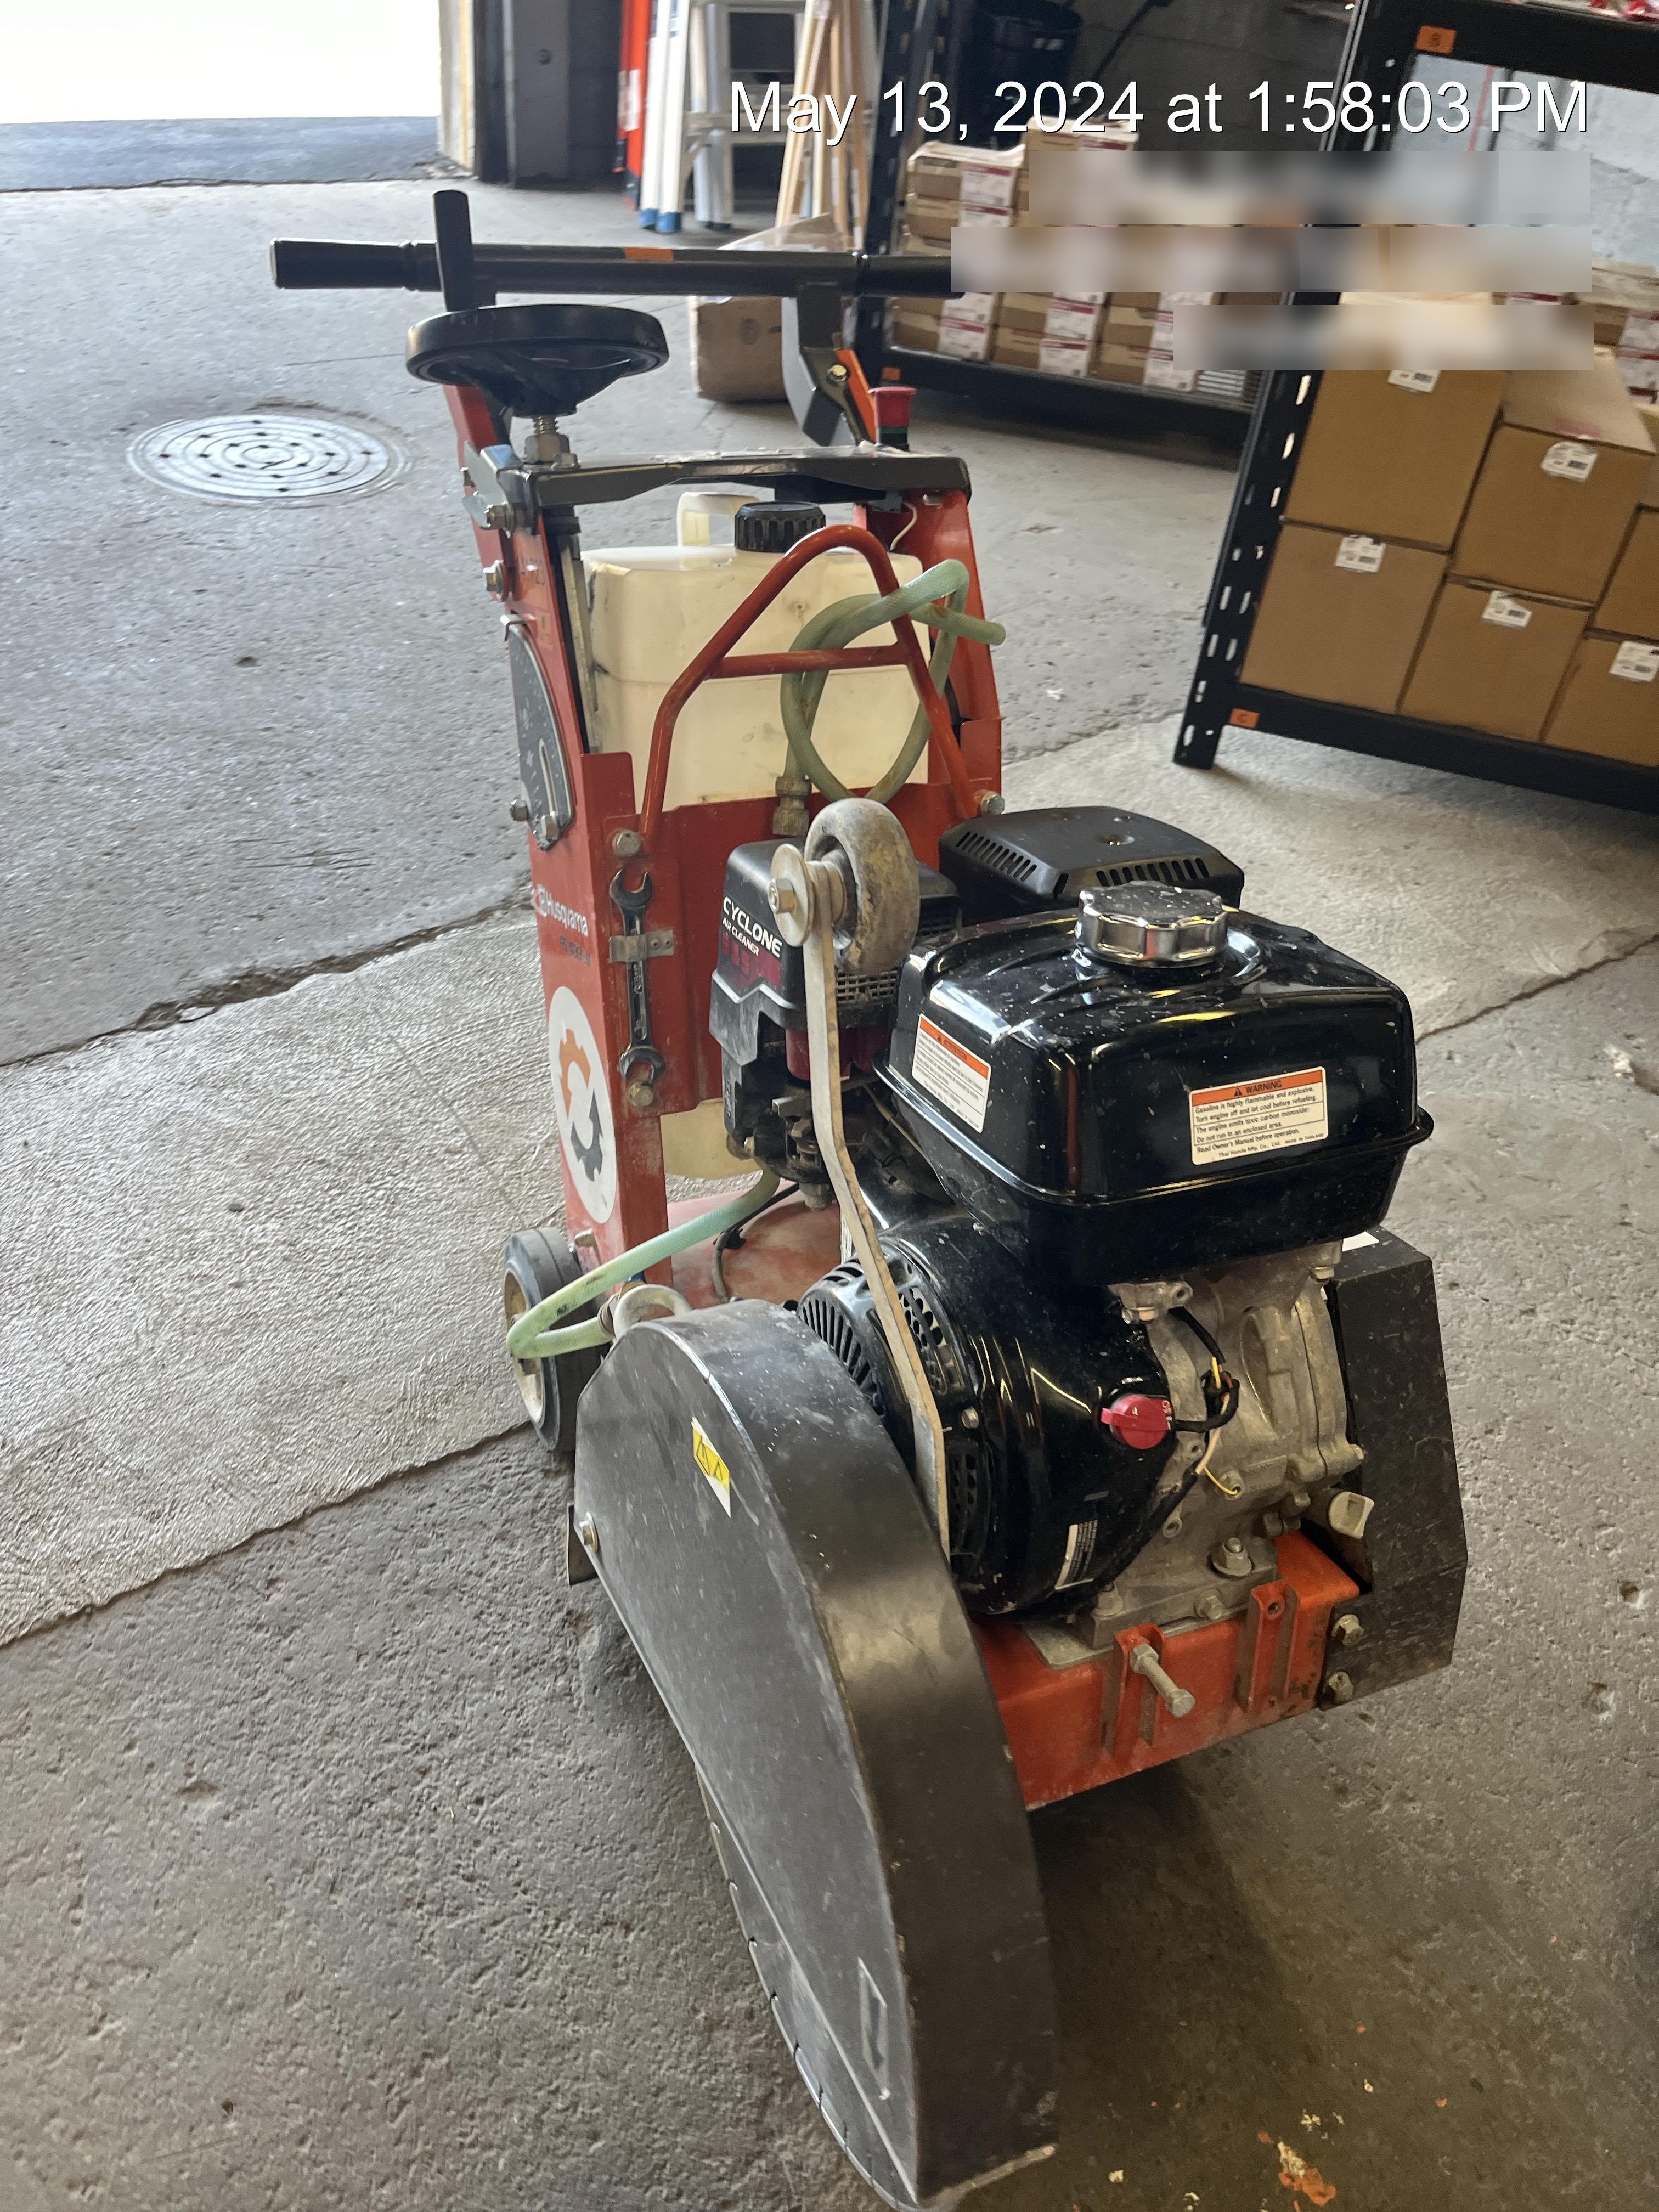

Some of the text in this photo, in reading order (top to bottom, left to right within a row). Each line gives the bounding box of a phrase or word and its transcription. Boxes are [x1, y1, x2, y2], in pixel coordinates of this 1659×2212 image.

[723, 896, 783, 958] CYCLONE
[721, 917, 760, 956] AIR CLEANER
[1246, 1080, 1282, 1093] WARNING
[1195, 1105, 1219, 1114] Gasoline
[1245, 1094, 1274, 1104] flammable
[1273, 1099, 1290, 1108] before
[1243, 1124, 1267, 1133] enclosed
[1212, 1142, 1234, 1150] Owner's
[1234, 1137, 1254, 1145] Manual
